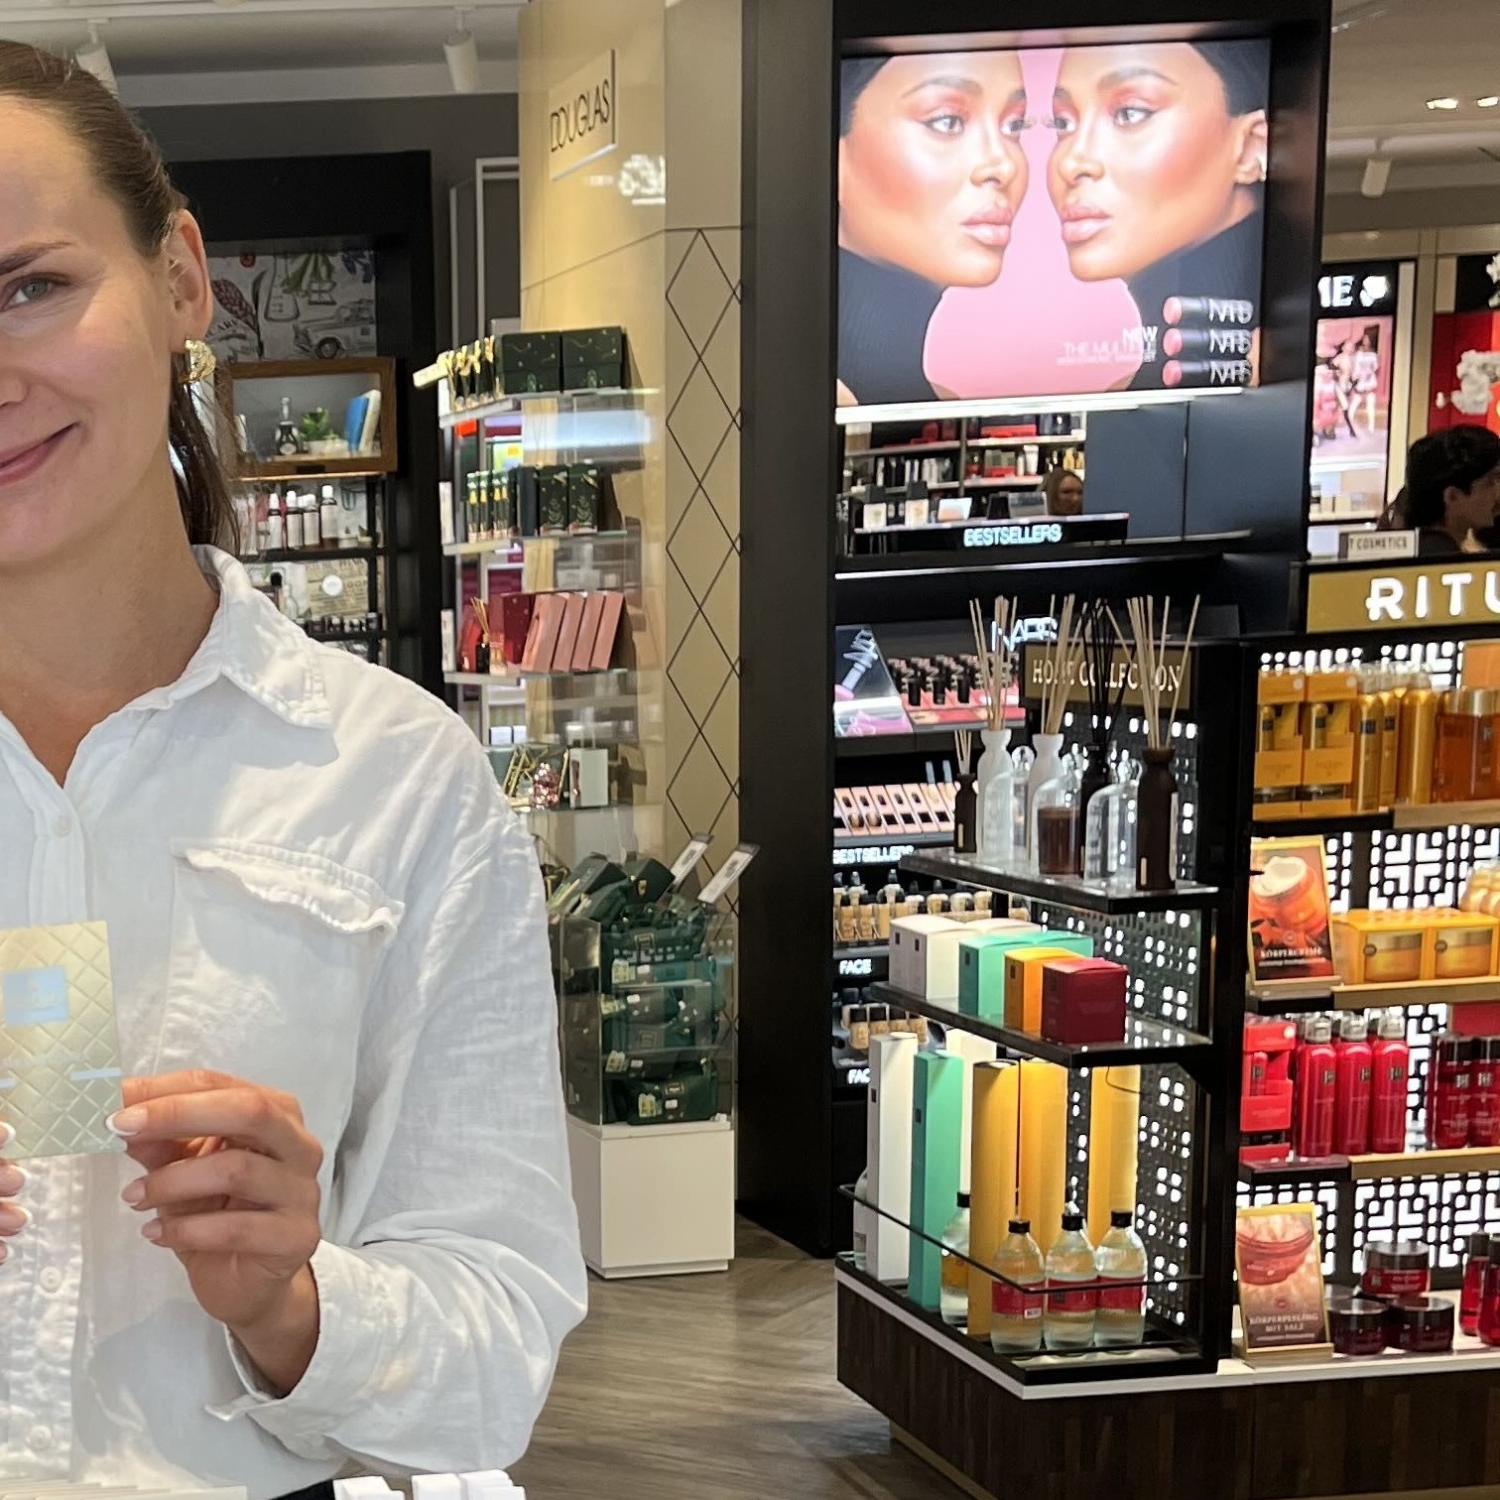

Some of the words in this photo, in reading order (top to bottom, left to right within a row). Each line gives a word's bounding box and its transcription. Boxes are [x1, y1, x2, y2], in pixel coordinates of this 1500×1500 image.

[550, 78, 610, 153] DOUGLAS
[963, 523, 1062, 548] BESTSELLERS
[1357, 536, 1407, 550] COSMETICS
[839, 958, 872, 976] FACE
